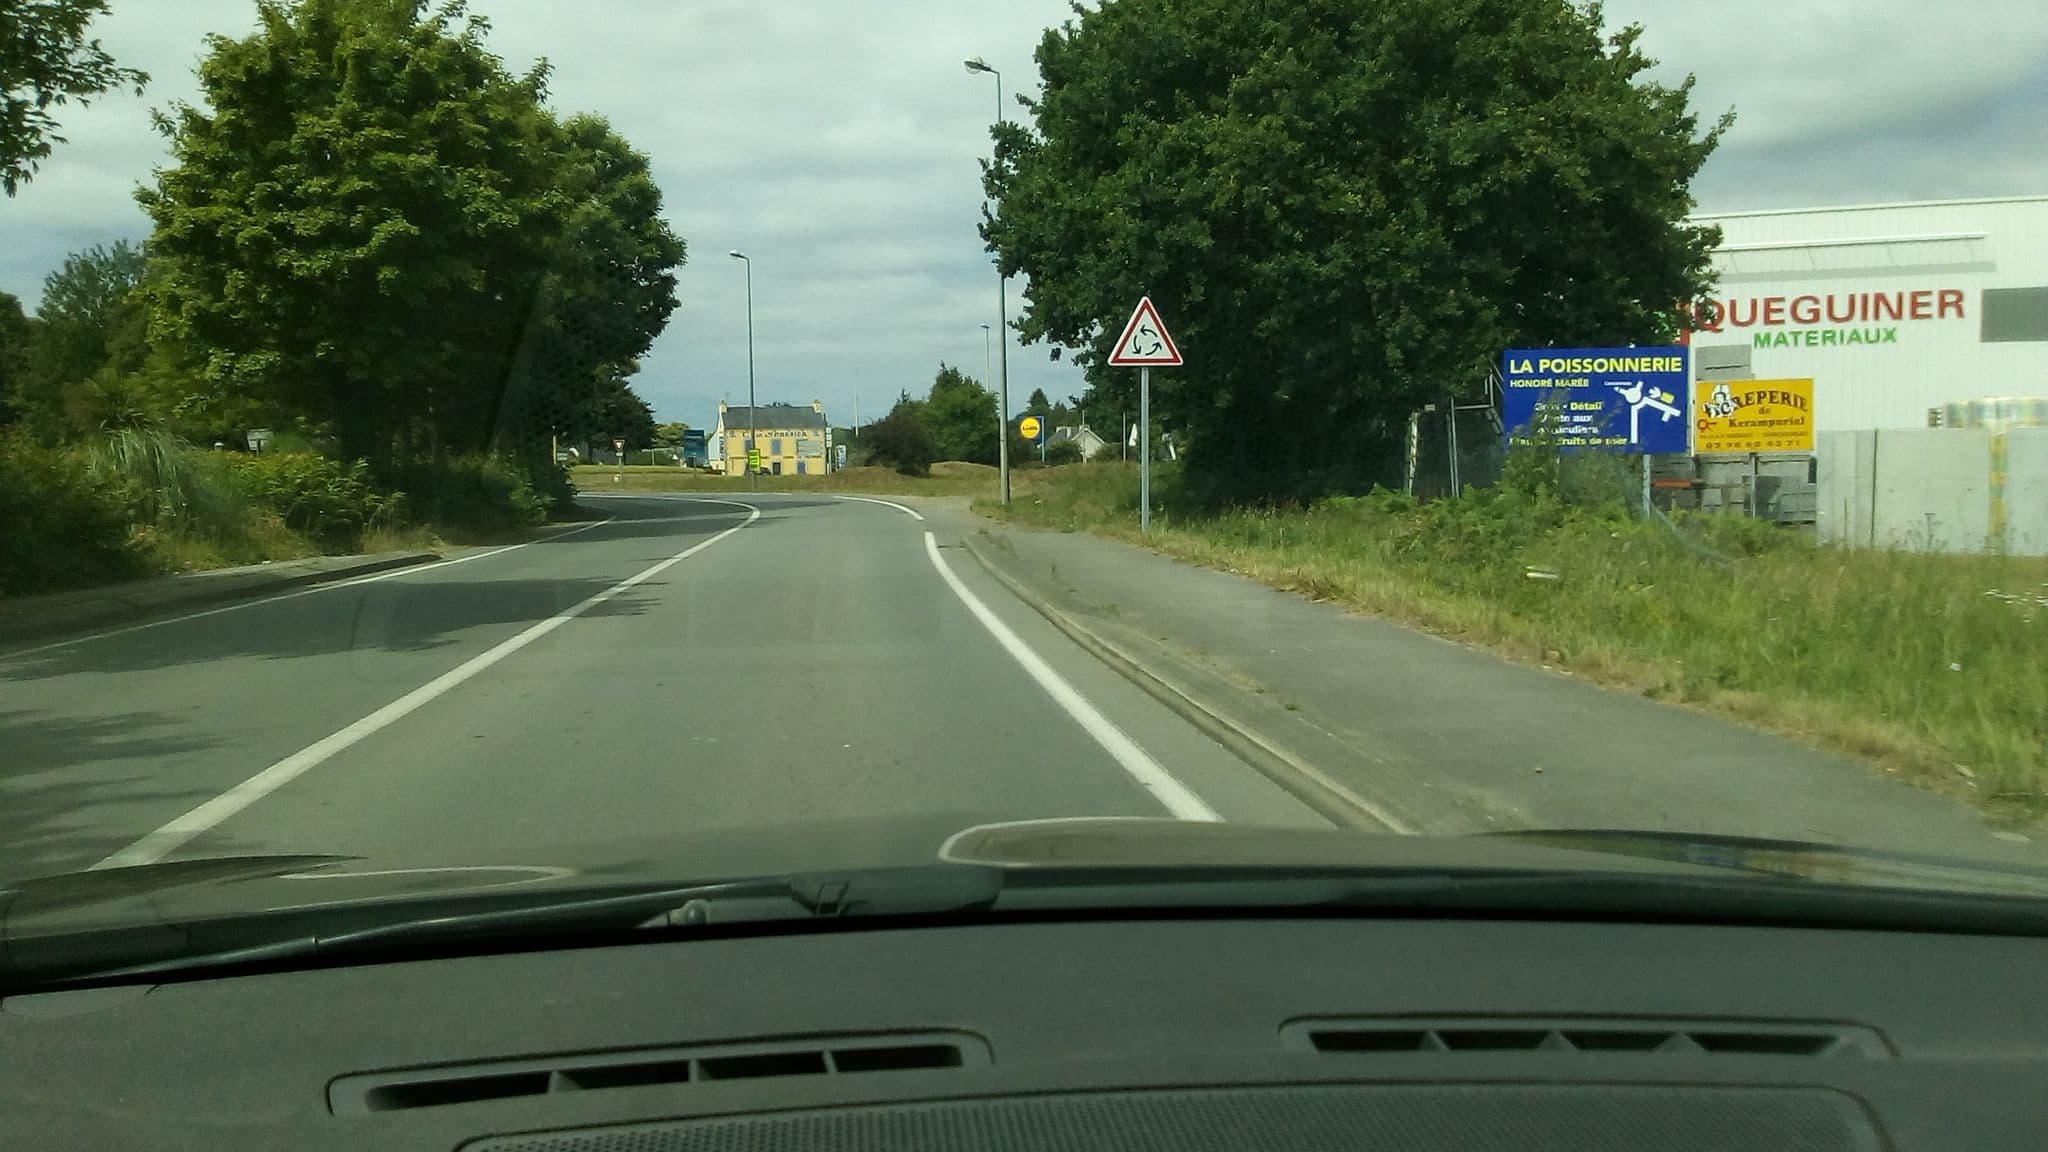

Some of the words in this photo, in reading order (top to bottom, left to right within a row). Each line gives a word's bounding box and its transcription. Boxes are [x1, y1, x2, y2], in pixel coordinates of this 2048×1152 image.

[1695, 289, 1965, 334] QUEGUINER
[1754, 327, 1897, 348] MATERIAUX
[1509, 359, 1534, 374] LA
[1539, 358, 1682, 373] POISSONNERIE
